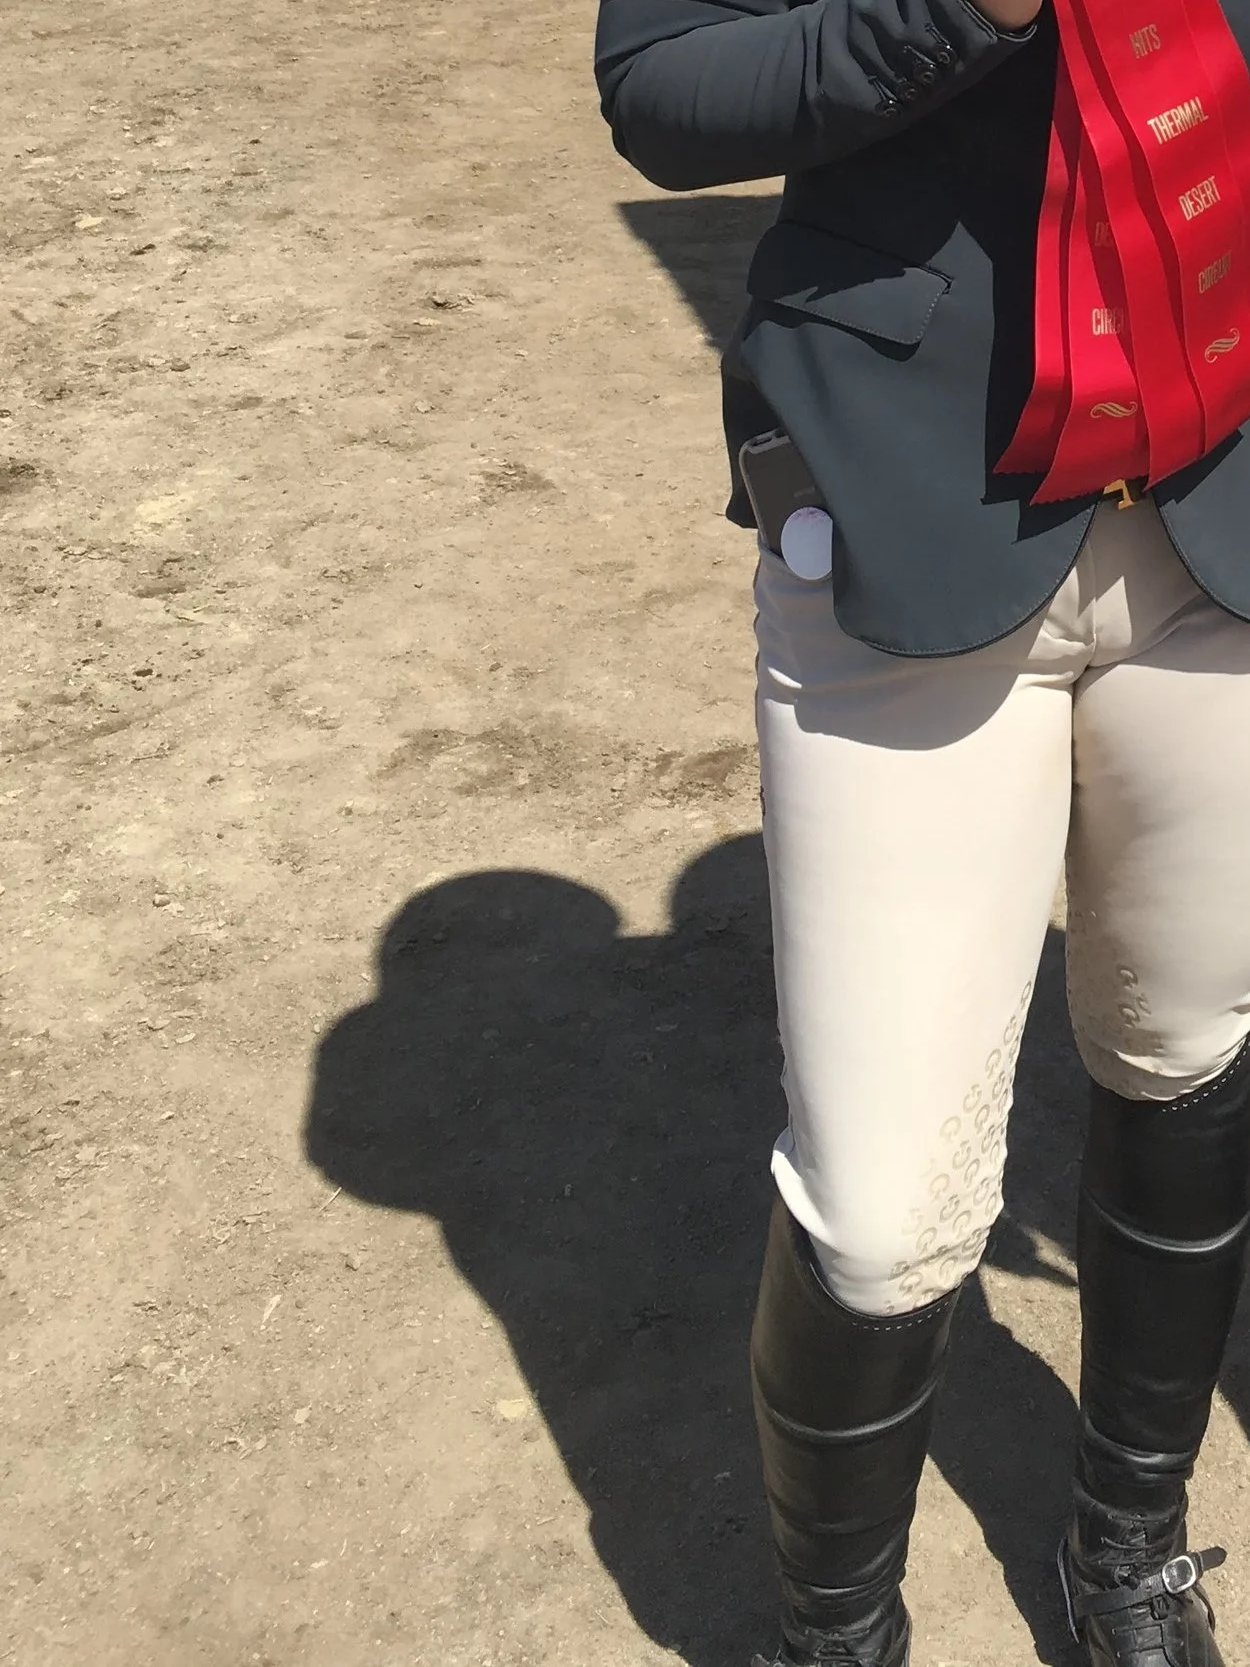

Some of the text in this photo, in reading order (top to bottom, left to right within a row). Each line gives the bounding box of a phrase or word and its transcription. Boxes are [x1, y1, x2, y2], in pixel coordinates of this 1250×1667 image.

[1129, 24, 1161, 59] HITS
[1147, 96, 1209, 145] THERMAL
[1178, 176, 1222, 222] DESERT
[1198, 250, 1232, 294] CIRCUIT
